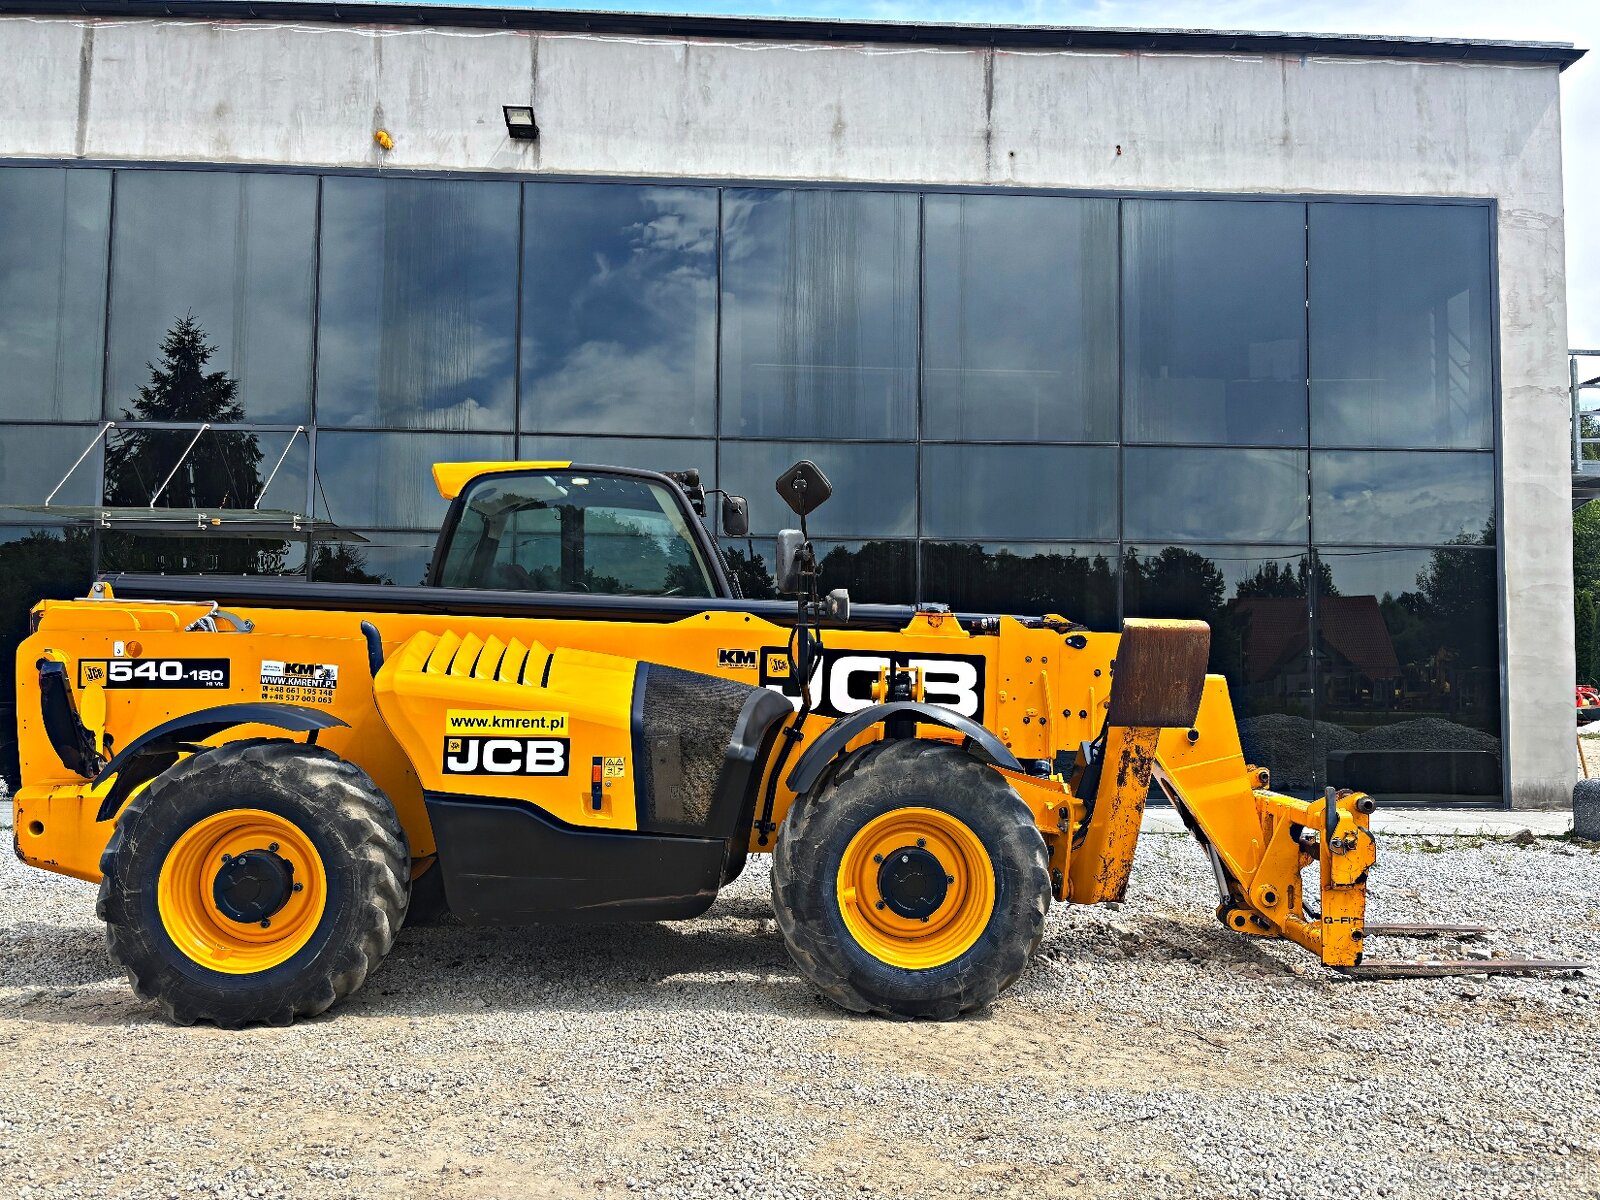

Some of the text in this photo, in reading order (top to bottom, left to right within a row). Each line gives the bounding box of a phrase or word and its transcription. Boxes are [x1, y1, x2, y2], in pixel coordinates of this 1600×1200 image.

[720, 650, 755, 663] KM
[85, 666, 104, 681] JCB
[109, 661, 224, 681] 540-180
[285, 663, 314, 674] KM
[261, 676, 336, 688] WWW.KMRENT.PL
[451, 716, 564, 731] www.kmrent.pl
[447, 739, 565, 773] JCB
